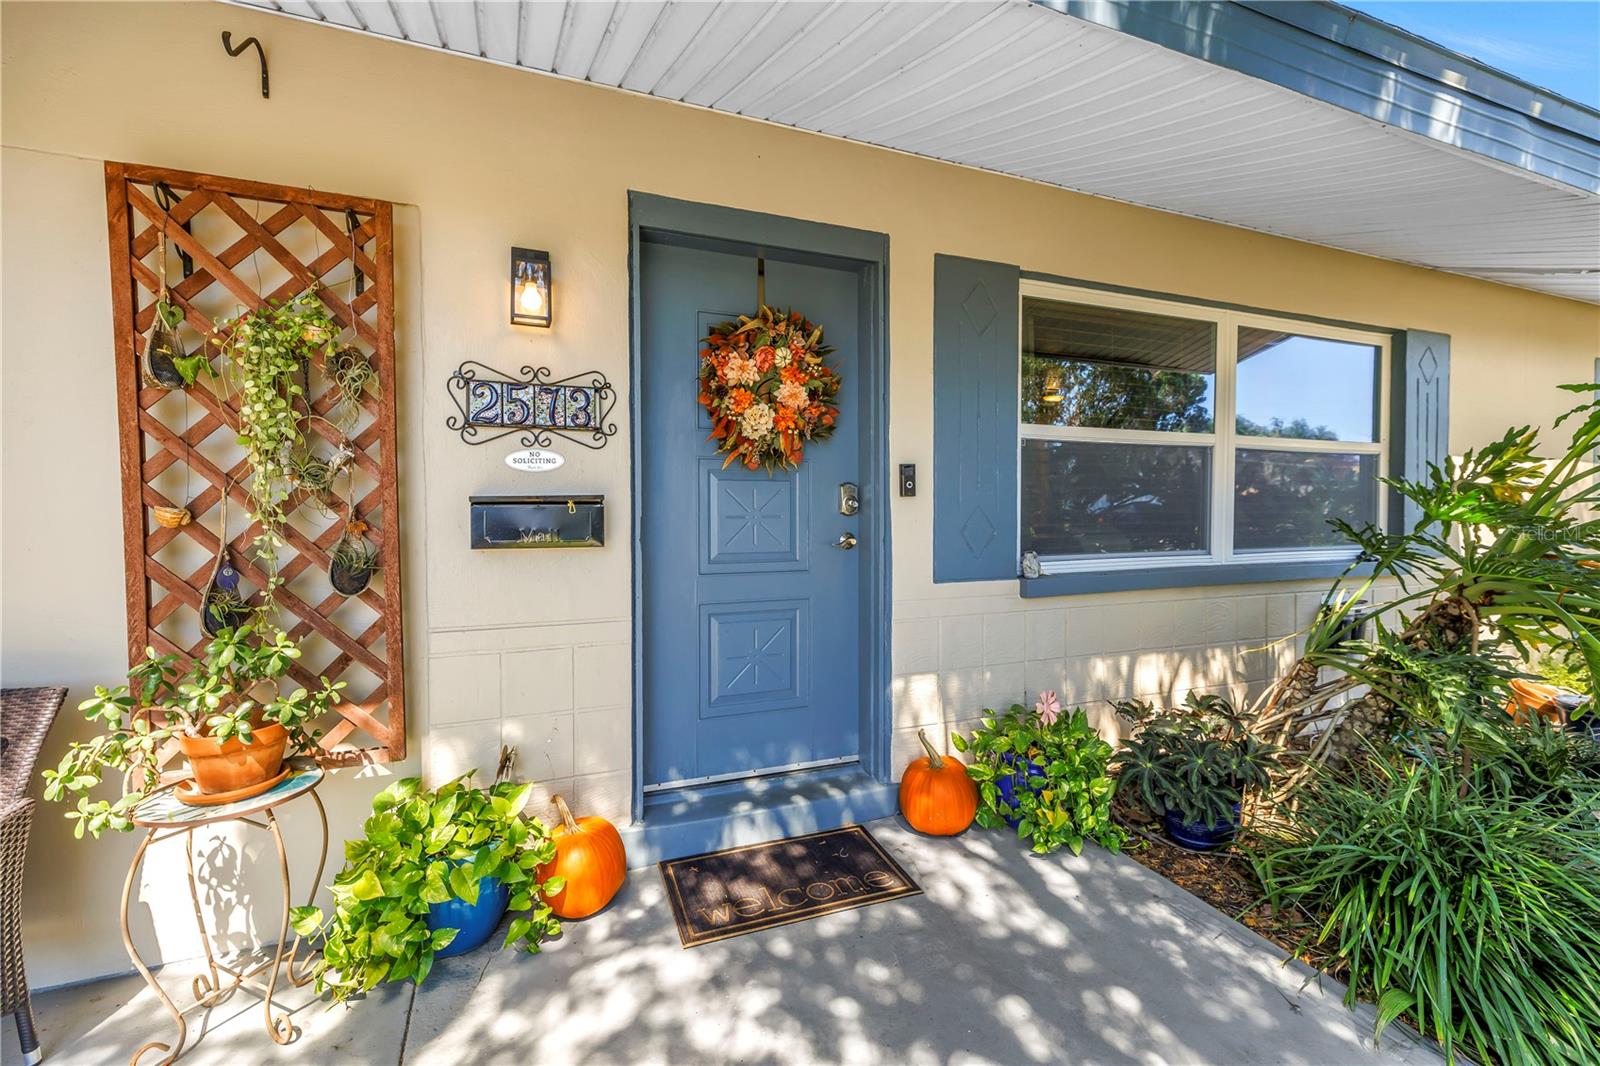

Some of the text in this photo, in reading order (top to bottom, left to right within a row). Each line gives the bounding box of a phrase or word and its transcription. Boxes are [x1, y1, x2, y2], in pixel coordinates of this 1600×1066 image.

[471, 382, 592, 427] 2573
[518, 528, 561, 543] Mail
[697, 871, 894, 925] welcome
